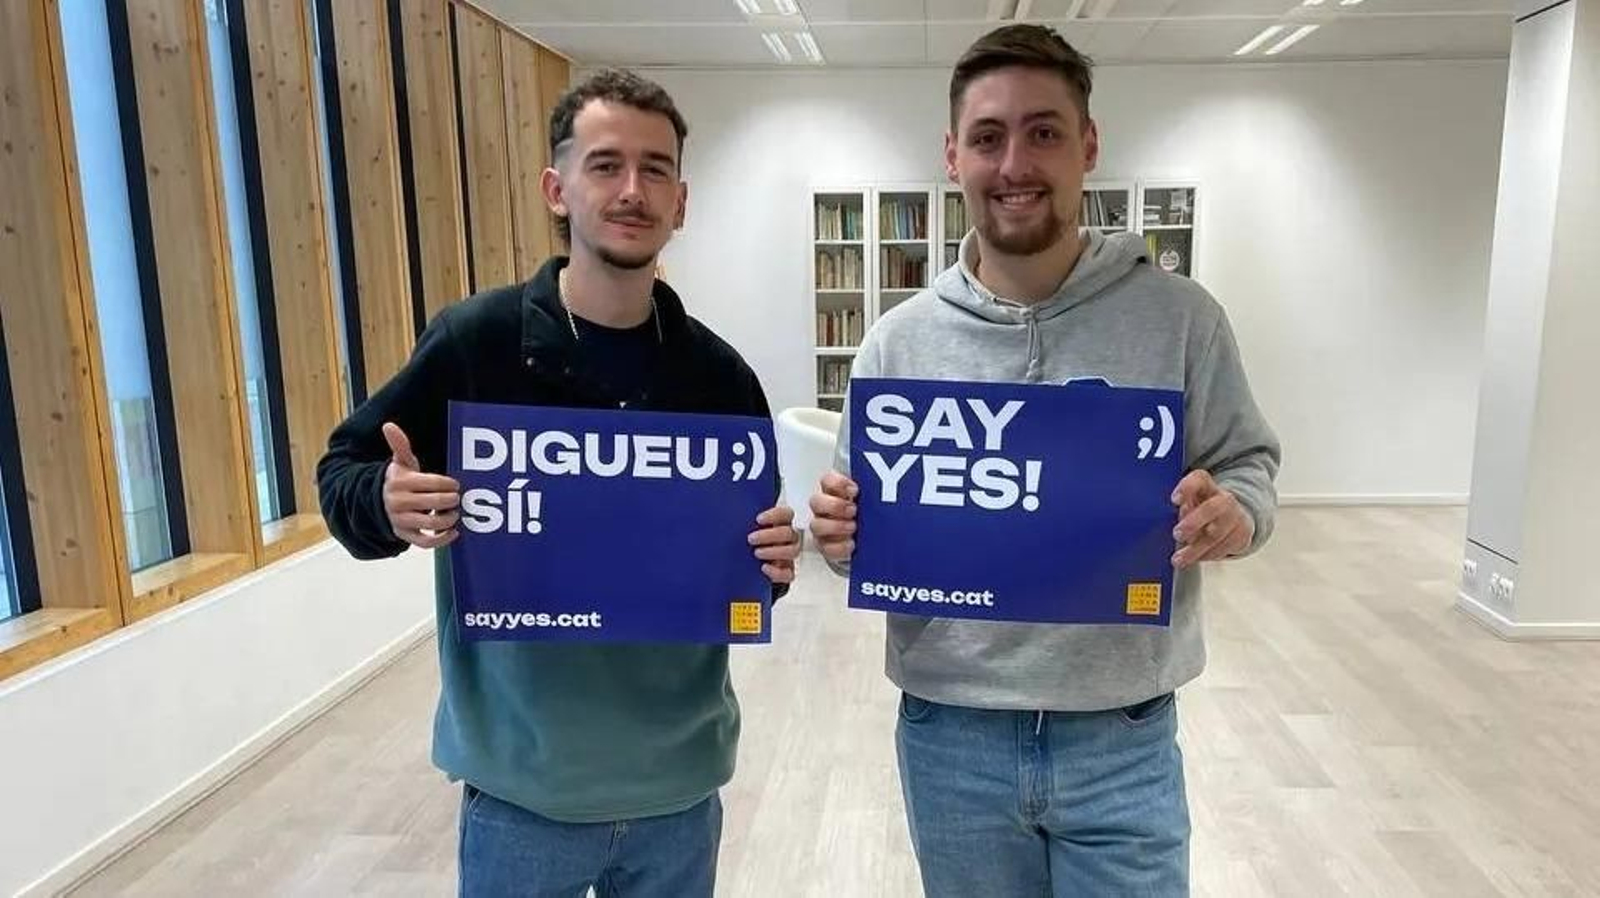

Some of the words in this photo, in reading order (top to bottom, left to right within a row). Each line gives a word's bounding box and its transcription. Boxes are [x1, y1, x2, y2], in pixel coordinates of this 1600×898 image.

[865, 393, 1026, 451] SAY
[462, 427, 719, 480] DIGUEU
[461, 478, 542, 534] SÍ!
[863, 451, 1042, 512] YES!
[464, 611, 602, 630] sayyes.cat
[860, 581, 994, 607] sayyes.cat
